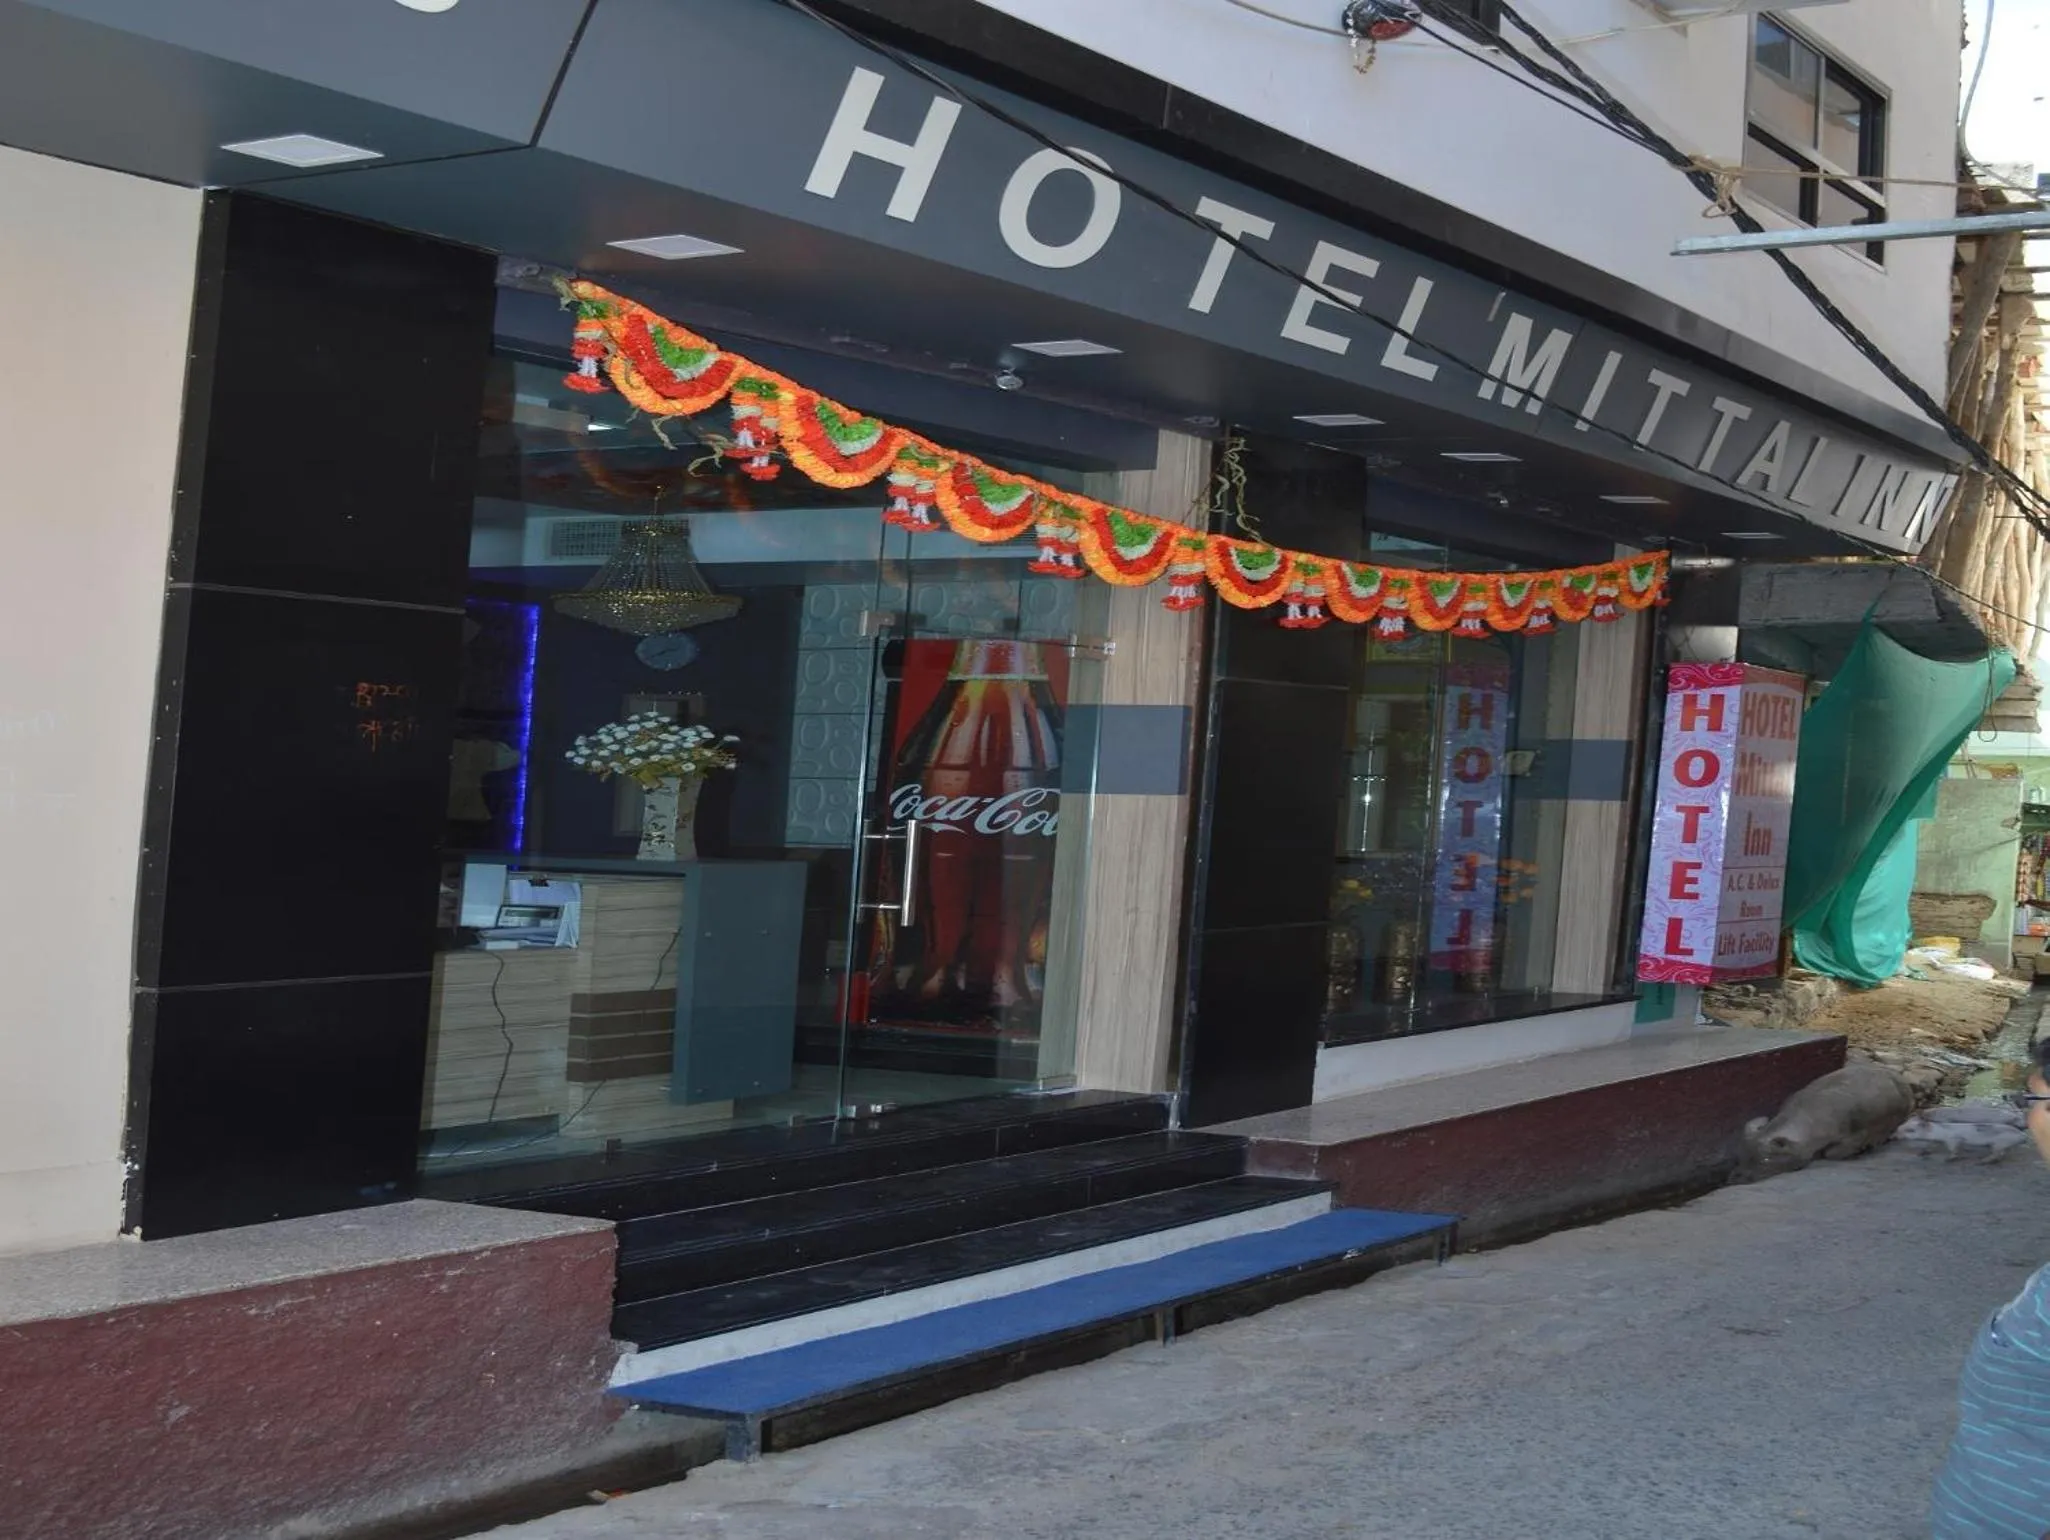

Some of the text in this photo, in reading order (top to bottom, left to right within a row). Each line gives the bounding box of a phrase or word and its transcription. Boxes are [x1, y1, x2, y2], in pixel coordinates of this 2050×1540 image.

[804, 66, 1959, 544] HOTEL MITTAL INN
[1739, 691, 1798, 742] HOTEL
[1664, 692, 1726, 957] HOTEL
[1744, 810, 1773, 857] Inn
[1718, 931, 1775, 956] Lift Facility
